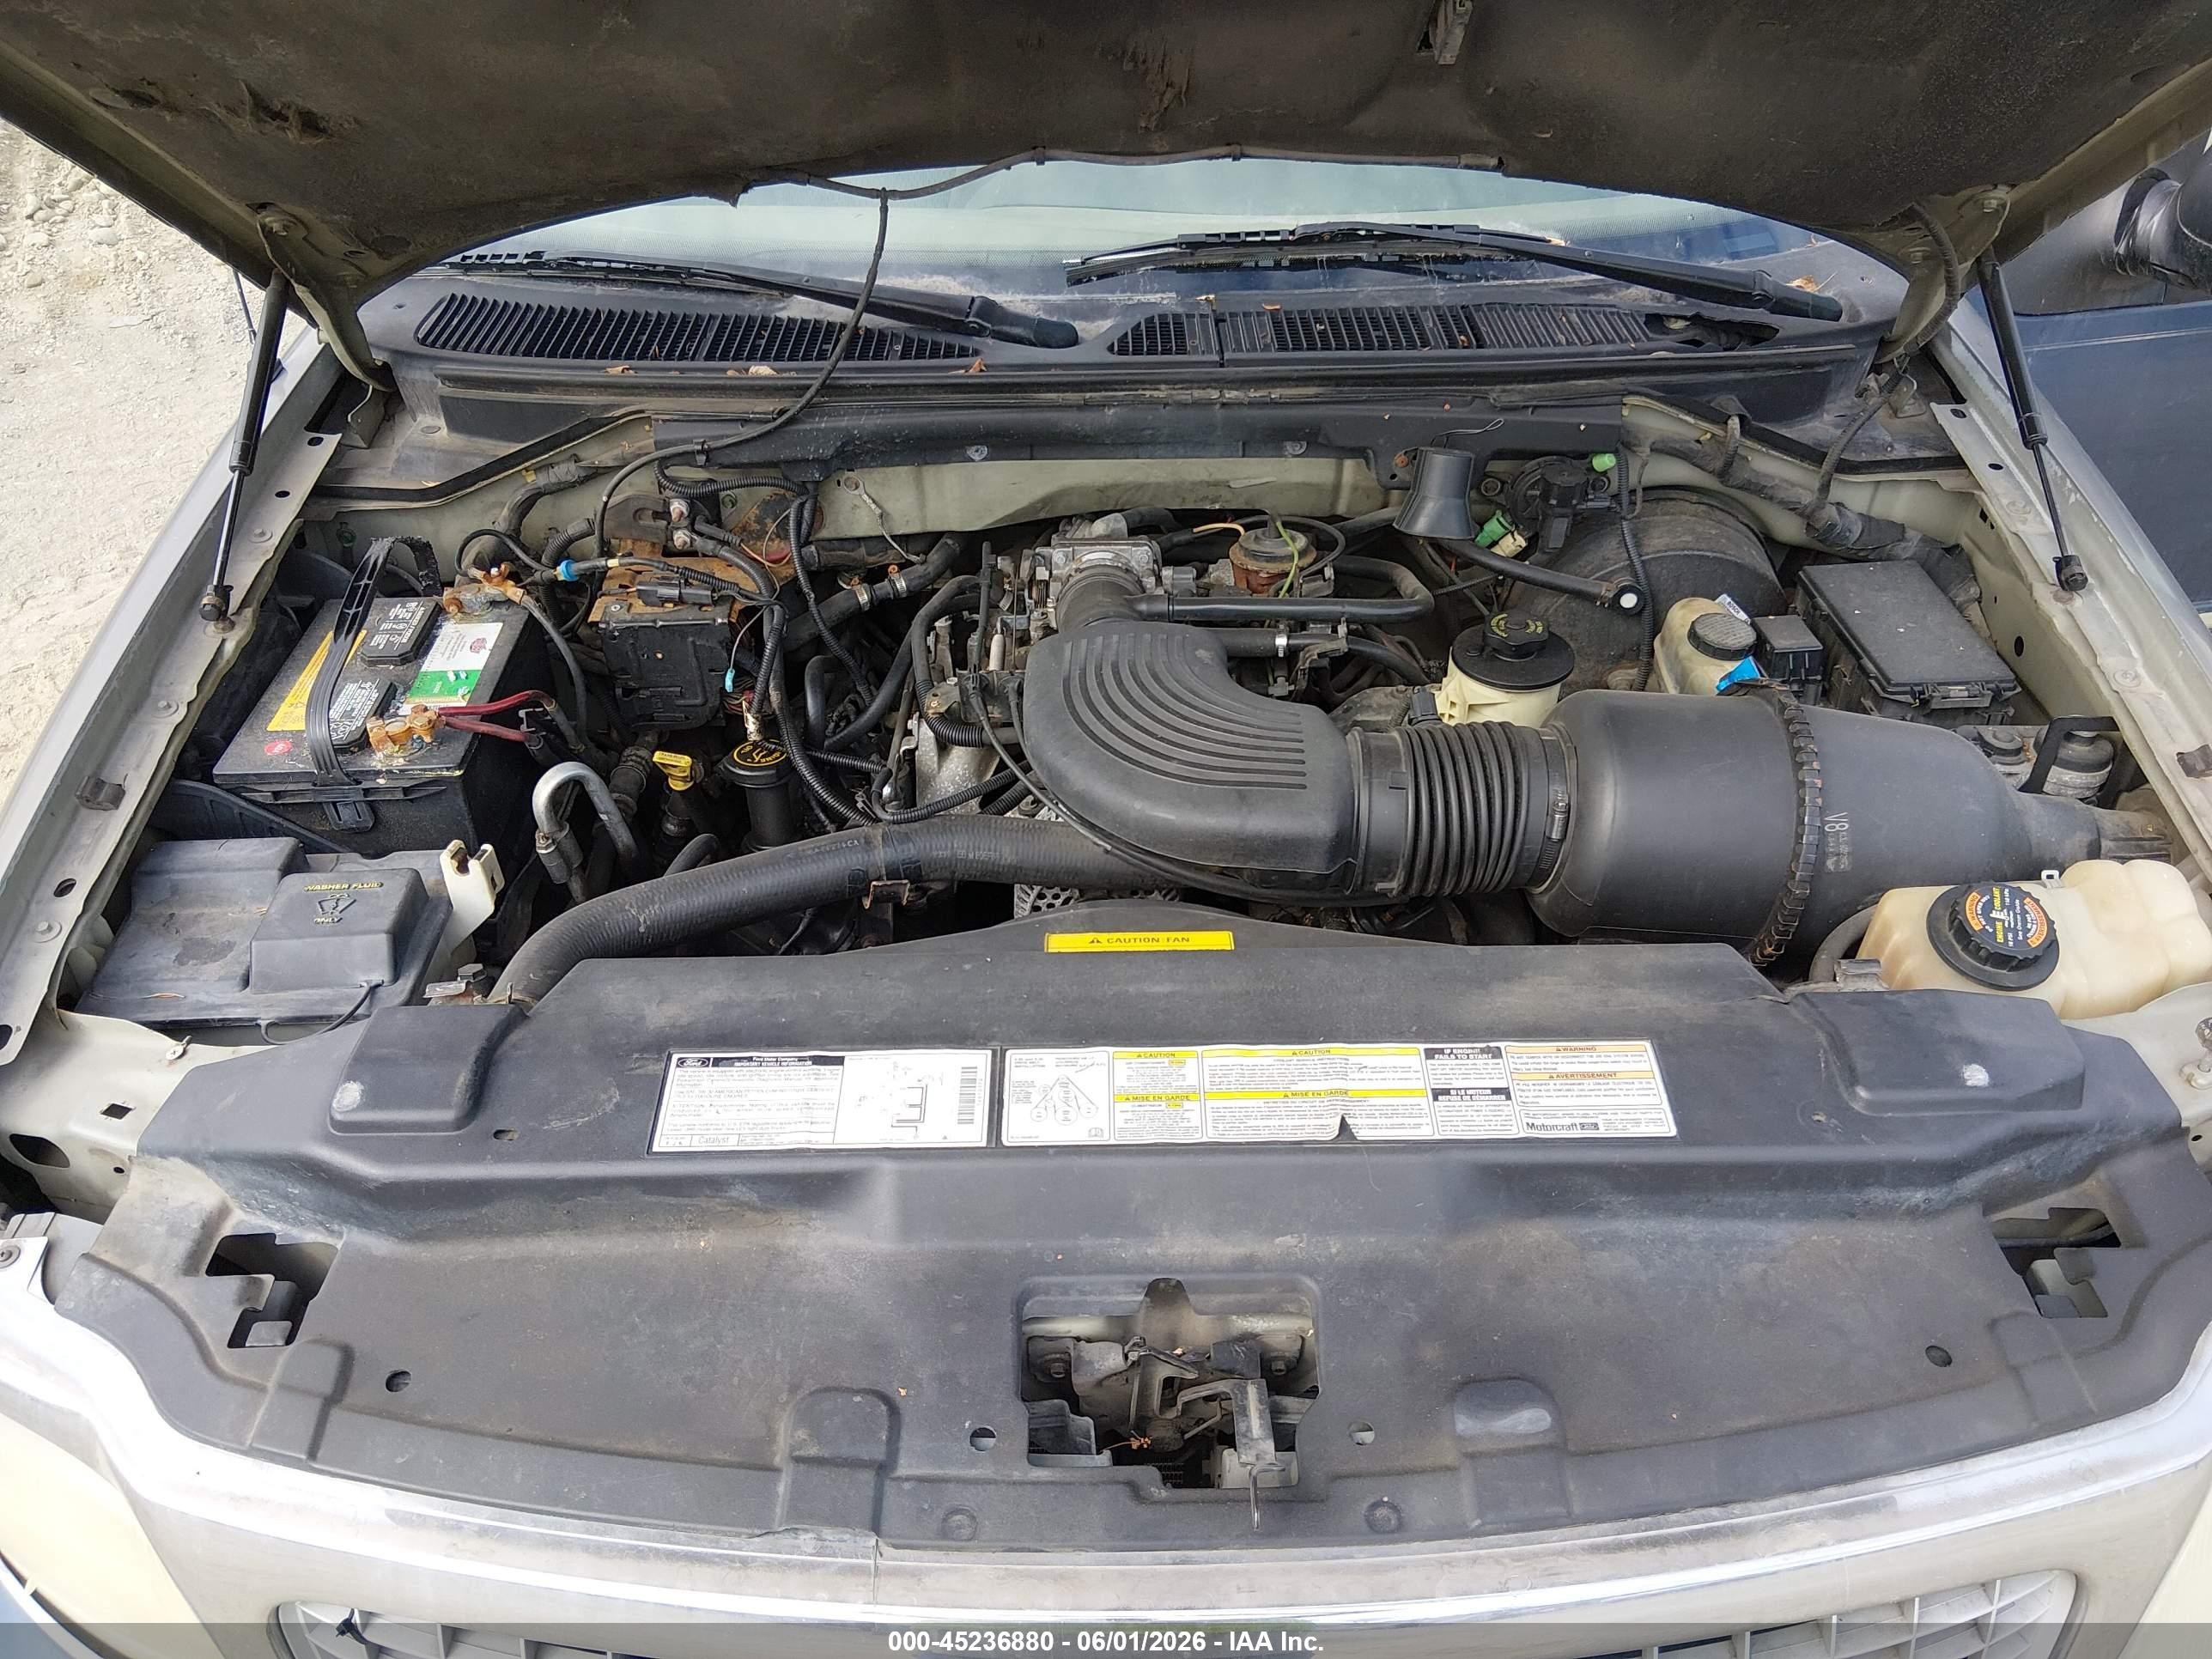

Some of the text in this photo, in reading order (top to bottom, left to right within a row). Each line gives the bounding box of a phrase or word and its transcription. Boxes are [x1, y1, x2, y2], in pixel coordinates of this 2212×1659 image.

[1824, 812, 1849, 832] V8
[1993, 887, 2004, 943] ENGINE COOLANT
[1526, 1123, 1579, 1131] Motorcraft
[698, 1137, 729, 1145] Catalyst
